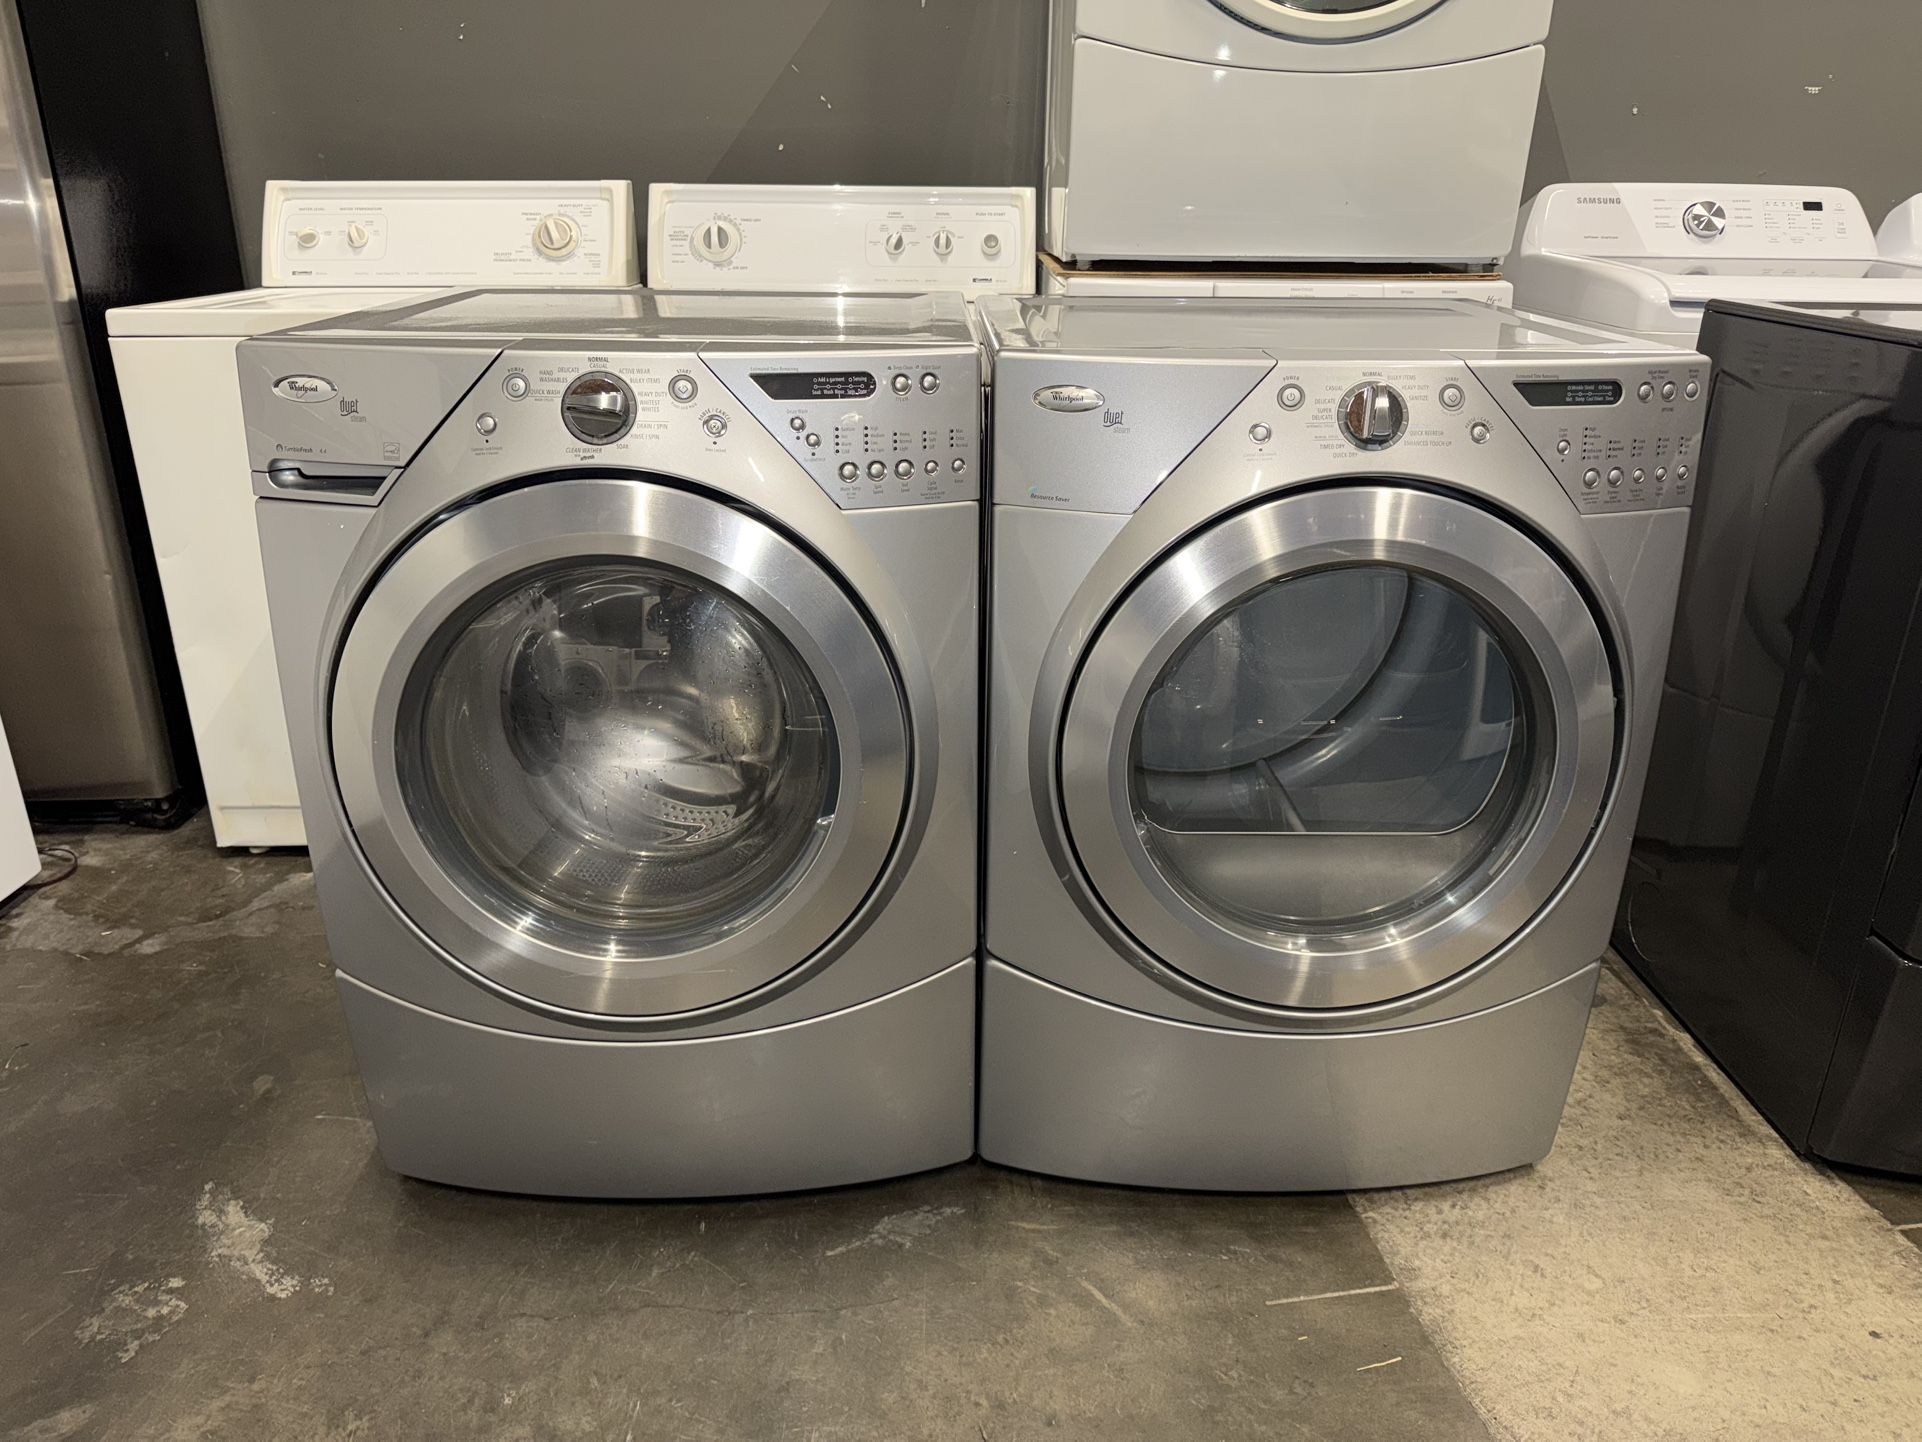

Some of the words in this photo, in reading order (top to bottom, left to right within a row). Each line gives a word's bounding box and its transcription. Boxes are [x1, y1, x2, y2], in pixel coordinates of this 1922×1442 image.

[1577, 197, 1621, 205] SAMSUNG
[288, 384, 318, 393] Whirlpool
[1052, 394, 1084, 403] Whirlpool
[340, 397, 359, 413] duet
[1103, 408, 1123, 424] duet
[1113, 426, 1130, 434] steam
[1030, 493, 1054, 501] Resource
